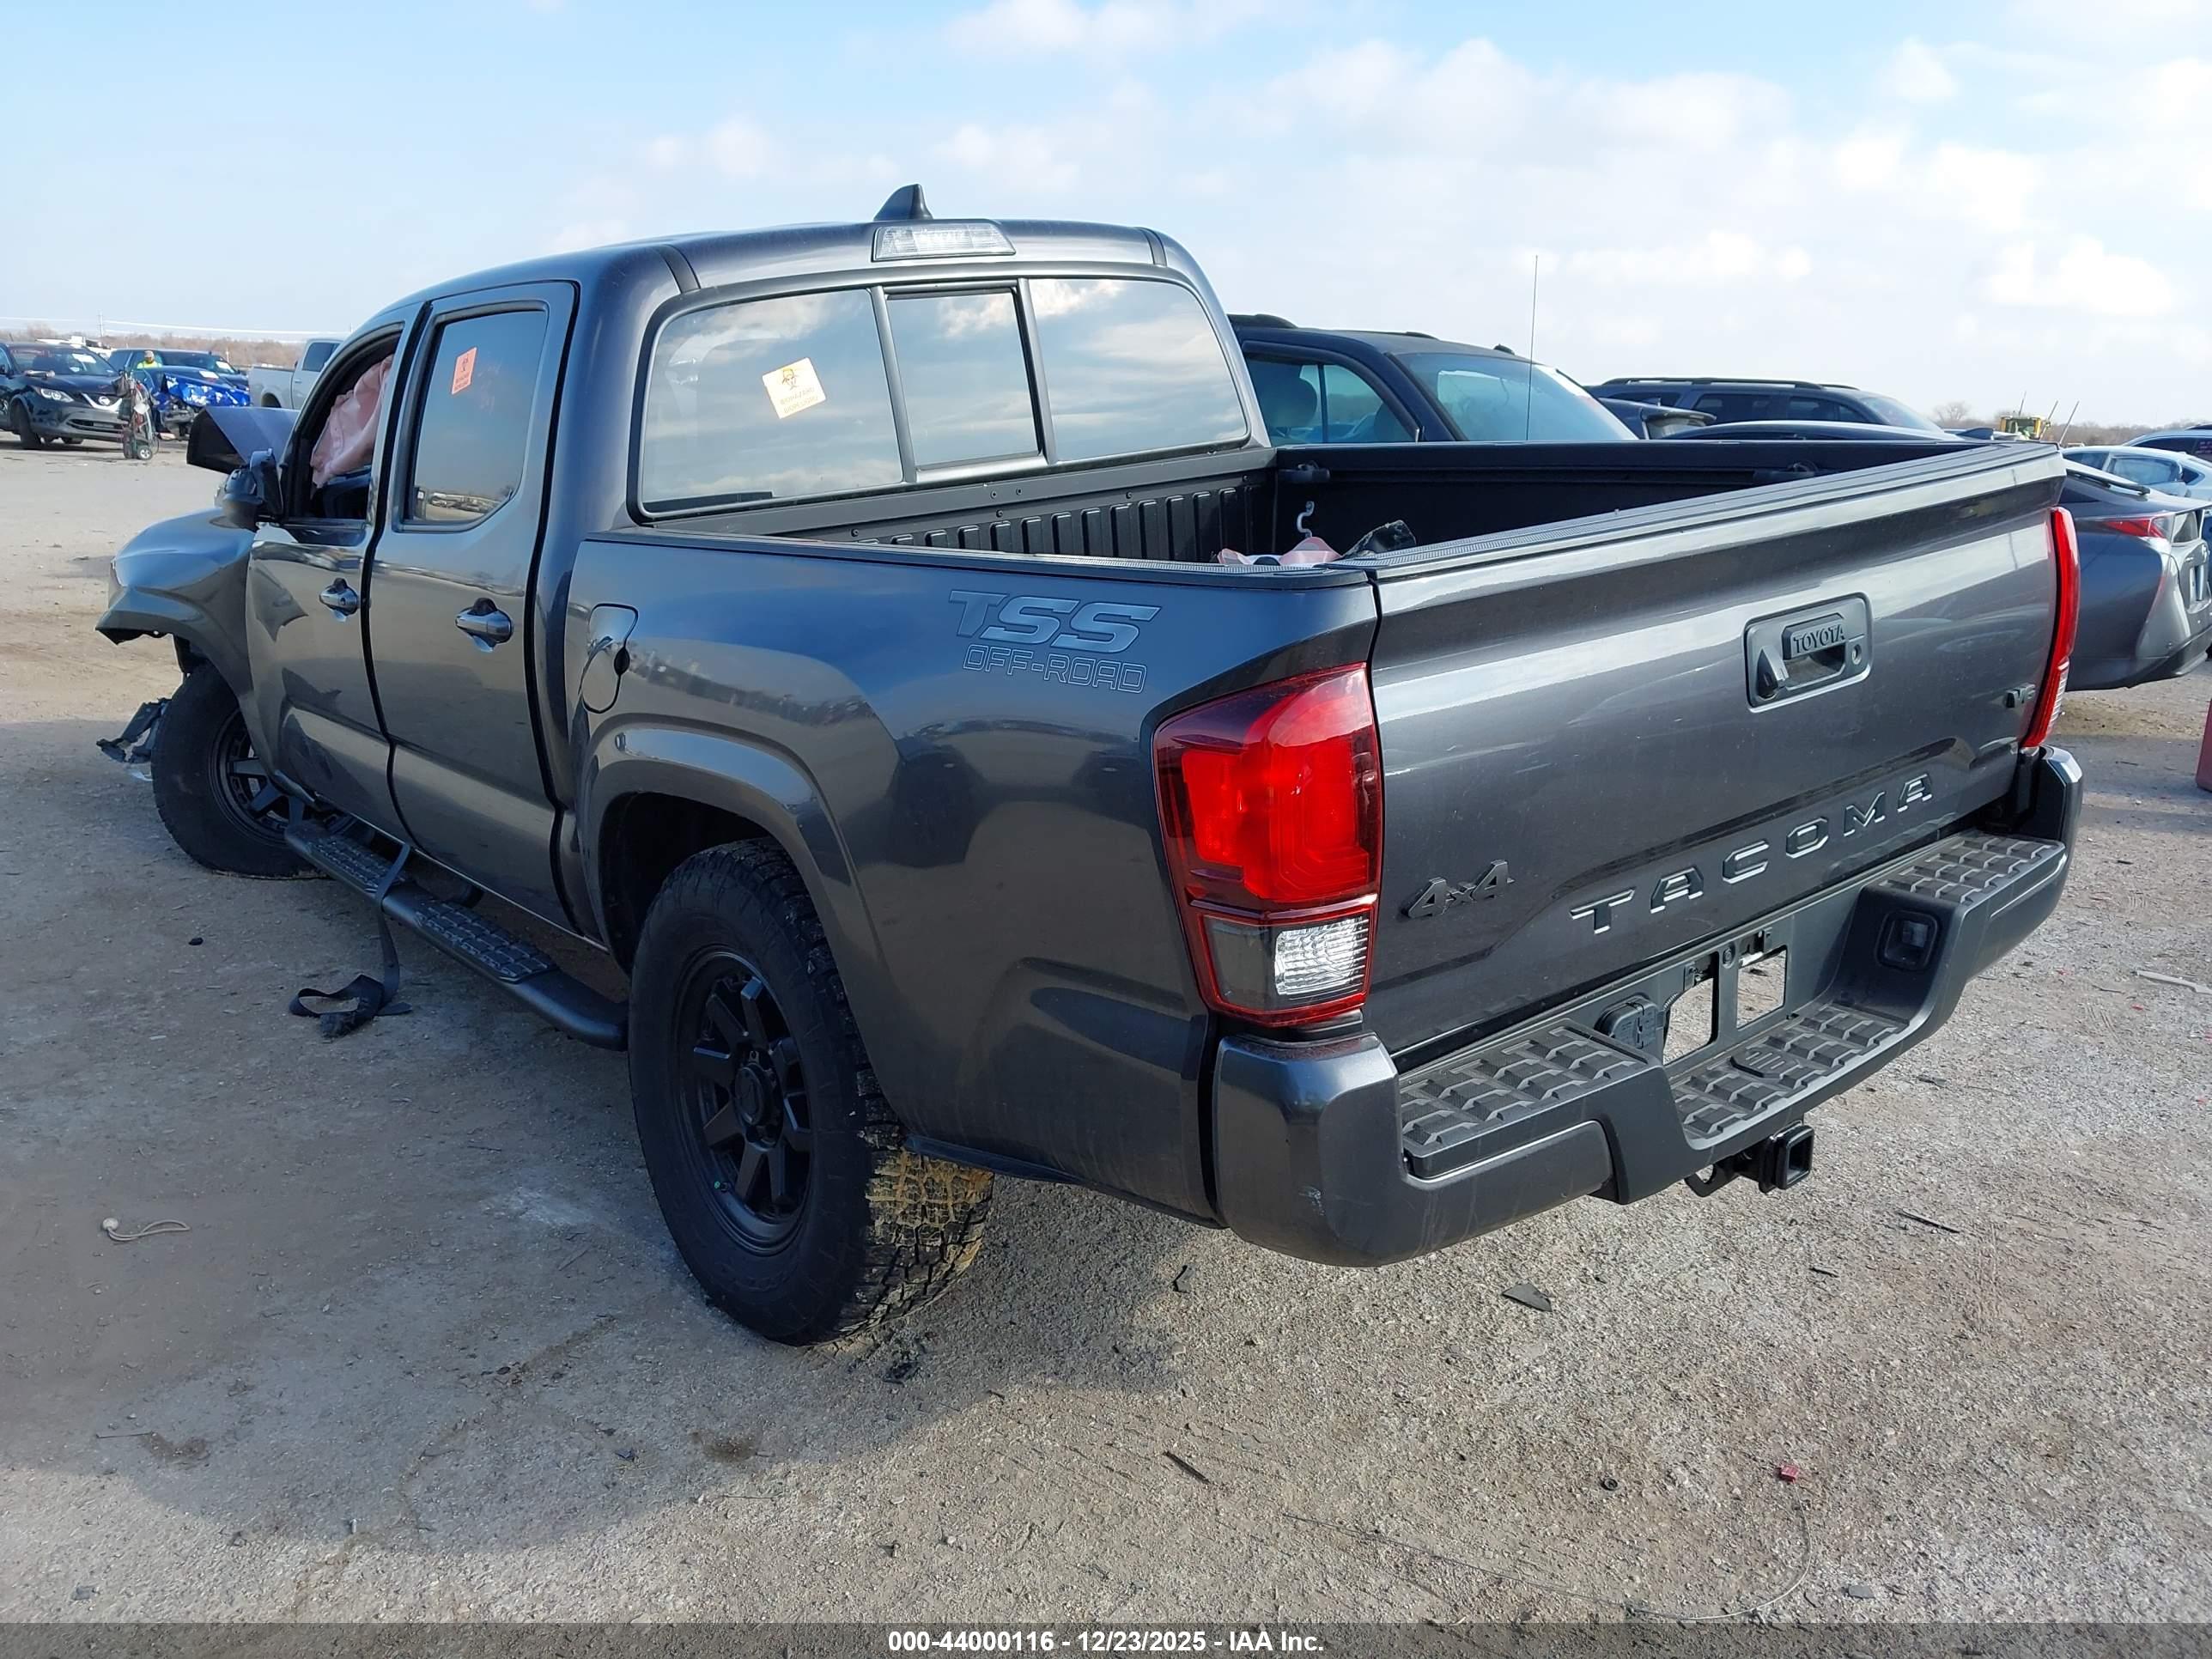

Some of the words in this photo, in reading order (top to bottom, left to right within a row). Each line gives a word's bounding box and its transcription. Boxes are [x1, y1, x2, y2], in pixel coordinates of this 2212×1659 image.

[948, 590, 1162, 653] TSS
[1793, 623, 1845, 653] TOYOTA
[963, 644, 1147, 694] OFF-ROAD
[1570, 774, 1933, 934] TACOMA
